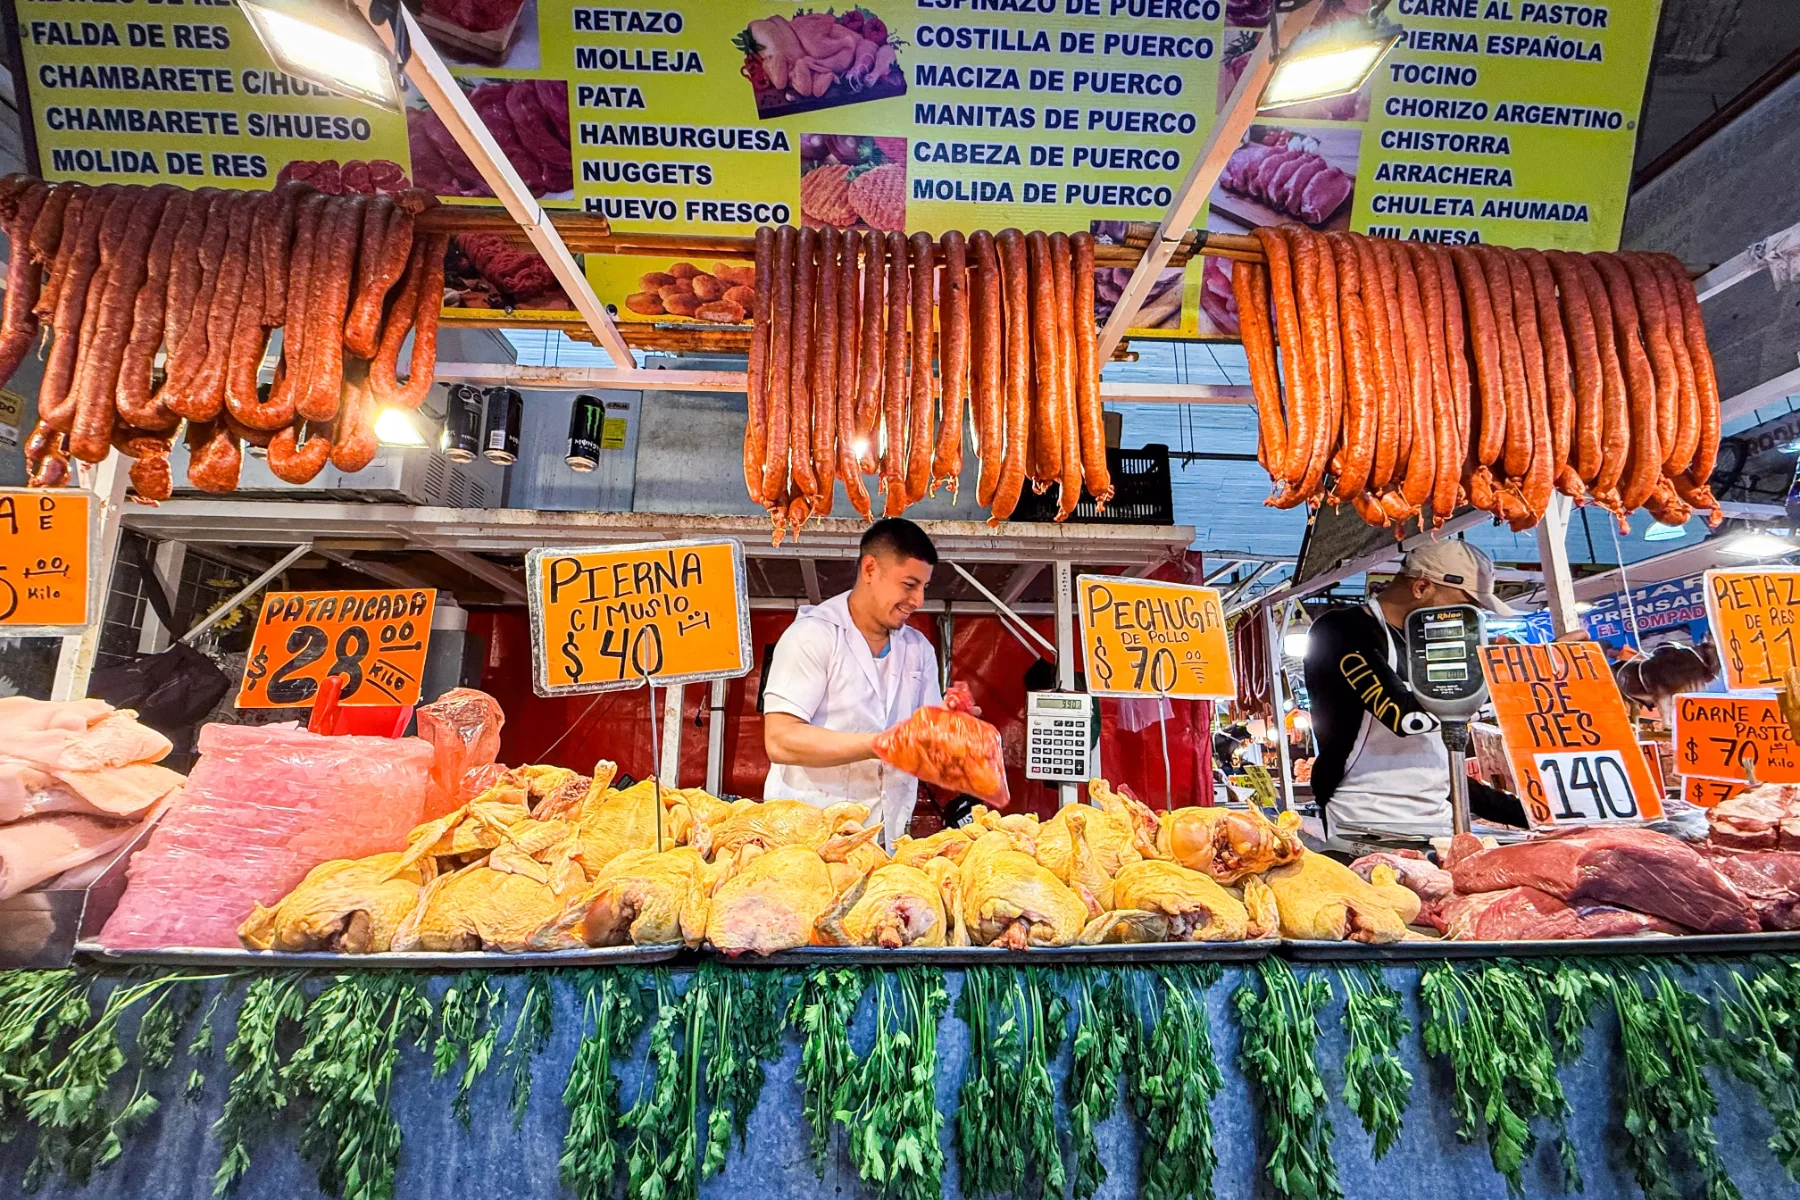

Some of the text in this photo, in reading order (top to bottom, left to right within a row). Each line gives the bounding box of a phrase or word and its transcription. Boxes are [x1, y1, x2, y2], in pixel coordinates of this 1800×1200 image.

[574, 9, 683, 34] RETAZO
[1065, 0, 1100, 15] DE
[1110, 0, 1220, 21] PUERCO
[1399, 0, 1608, 28] CARNE AL PASTOR
[31, 21, 230, 49] FALDA DE RES
[916, 25, 1214, 59] COSTILLA DE PUERCO
[1394, 30, 1603, 61] PIERNA ESPAÑOLA
[576, 48, 703, 73] MOLLEJA
[1390, 63, 1477, 86] TOCINO
[39, 64, 346, 97] CHAMBARETE C/HU
[915, 65, 1182, 96] MACIZA DE PUERCO
[578, 86, 645, 108] PATA
[46, 107, 371, 141] CHAMBARETE S/HUESO
[914, 103, 1196, 134] MANITAS DE PUERCO
[1385, 97, 1622, 130] CHORIZO ARGENTINO
[580, 124, 790, 151] HAMBURGUESA
[1380, 130, 1510, 155] CHISTORRA
[52, 149, 267, 178] MOLIDA DE RES
[913, 142, 1180, 170] CABEZA DE PUERCO
[582, 161, 712, 185] NUGGETS
[1375, 163, 1513, 187] ARRACHERA
[913, 179, 1172, 207] MOLIDA DE PUERCO
[585, 198, 790, 224] HUEVO FRESCO
[1372, 195, 1589, 222] CHULETA AHUMADA
[550, 550, 702, 603] PIERNA
[1712, 575, 1800, 610] RETAZ
[266, 591, 427, 625] PATA PICADA
[1088, 584, 1220, 633] PECHUGA
[1745, 607, 1794, 629] DE RES
[1121, 630, 1190, 645] DE POLLO
[1597, 623, 1620, 638] EL
[246, 620, 414, 704] $ 28 00
[561, 631, 583, 683] $
[600, 623, 663, 679] 40
[1094, 636, 1113, 689] $
[1125, 646, 1177, 692] 70
[1730, 629, 1744, 684] $
[1530, 682, 1580, 714] DE
[1682, 698, 1749, 722] CARNE
[1526, 712, 1600, 747] RES
[1684, 737, 1758, 767] $ 70
[1524, 756, 1637, 822] $ 140
